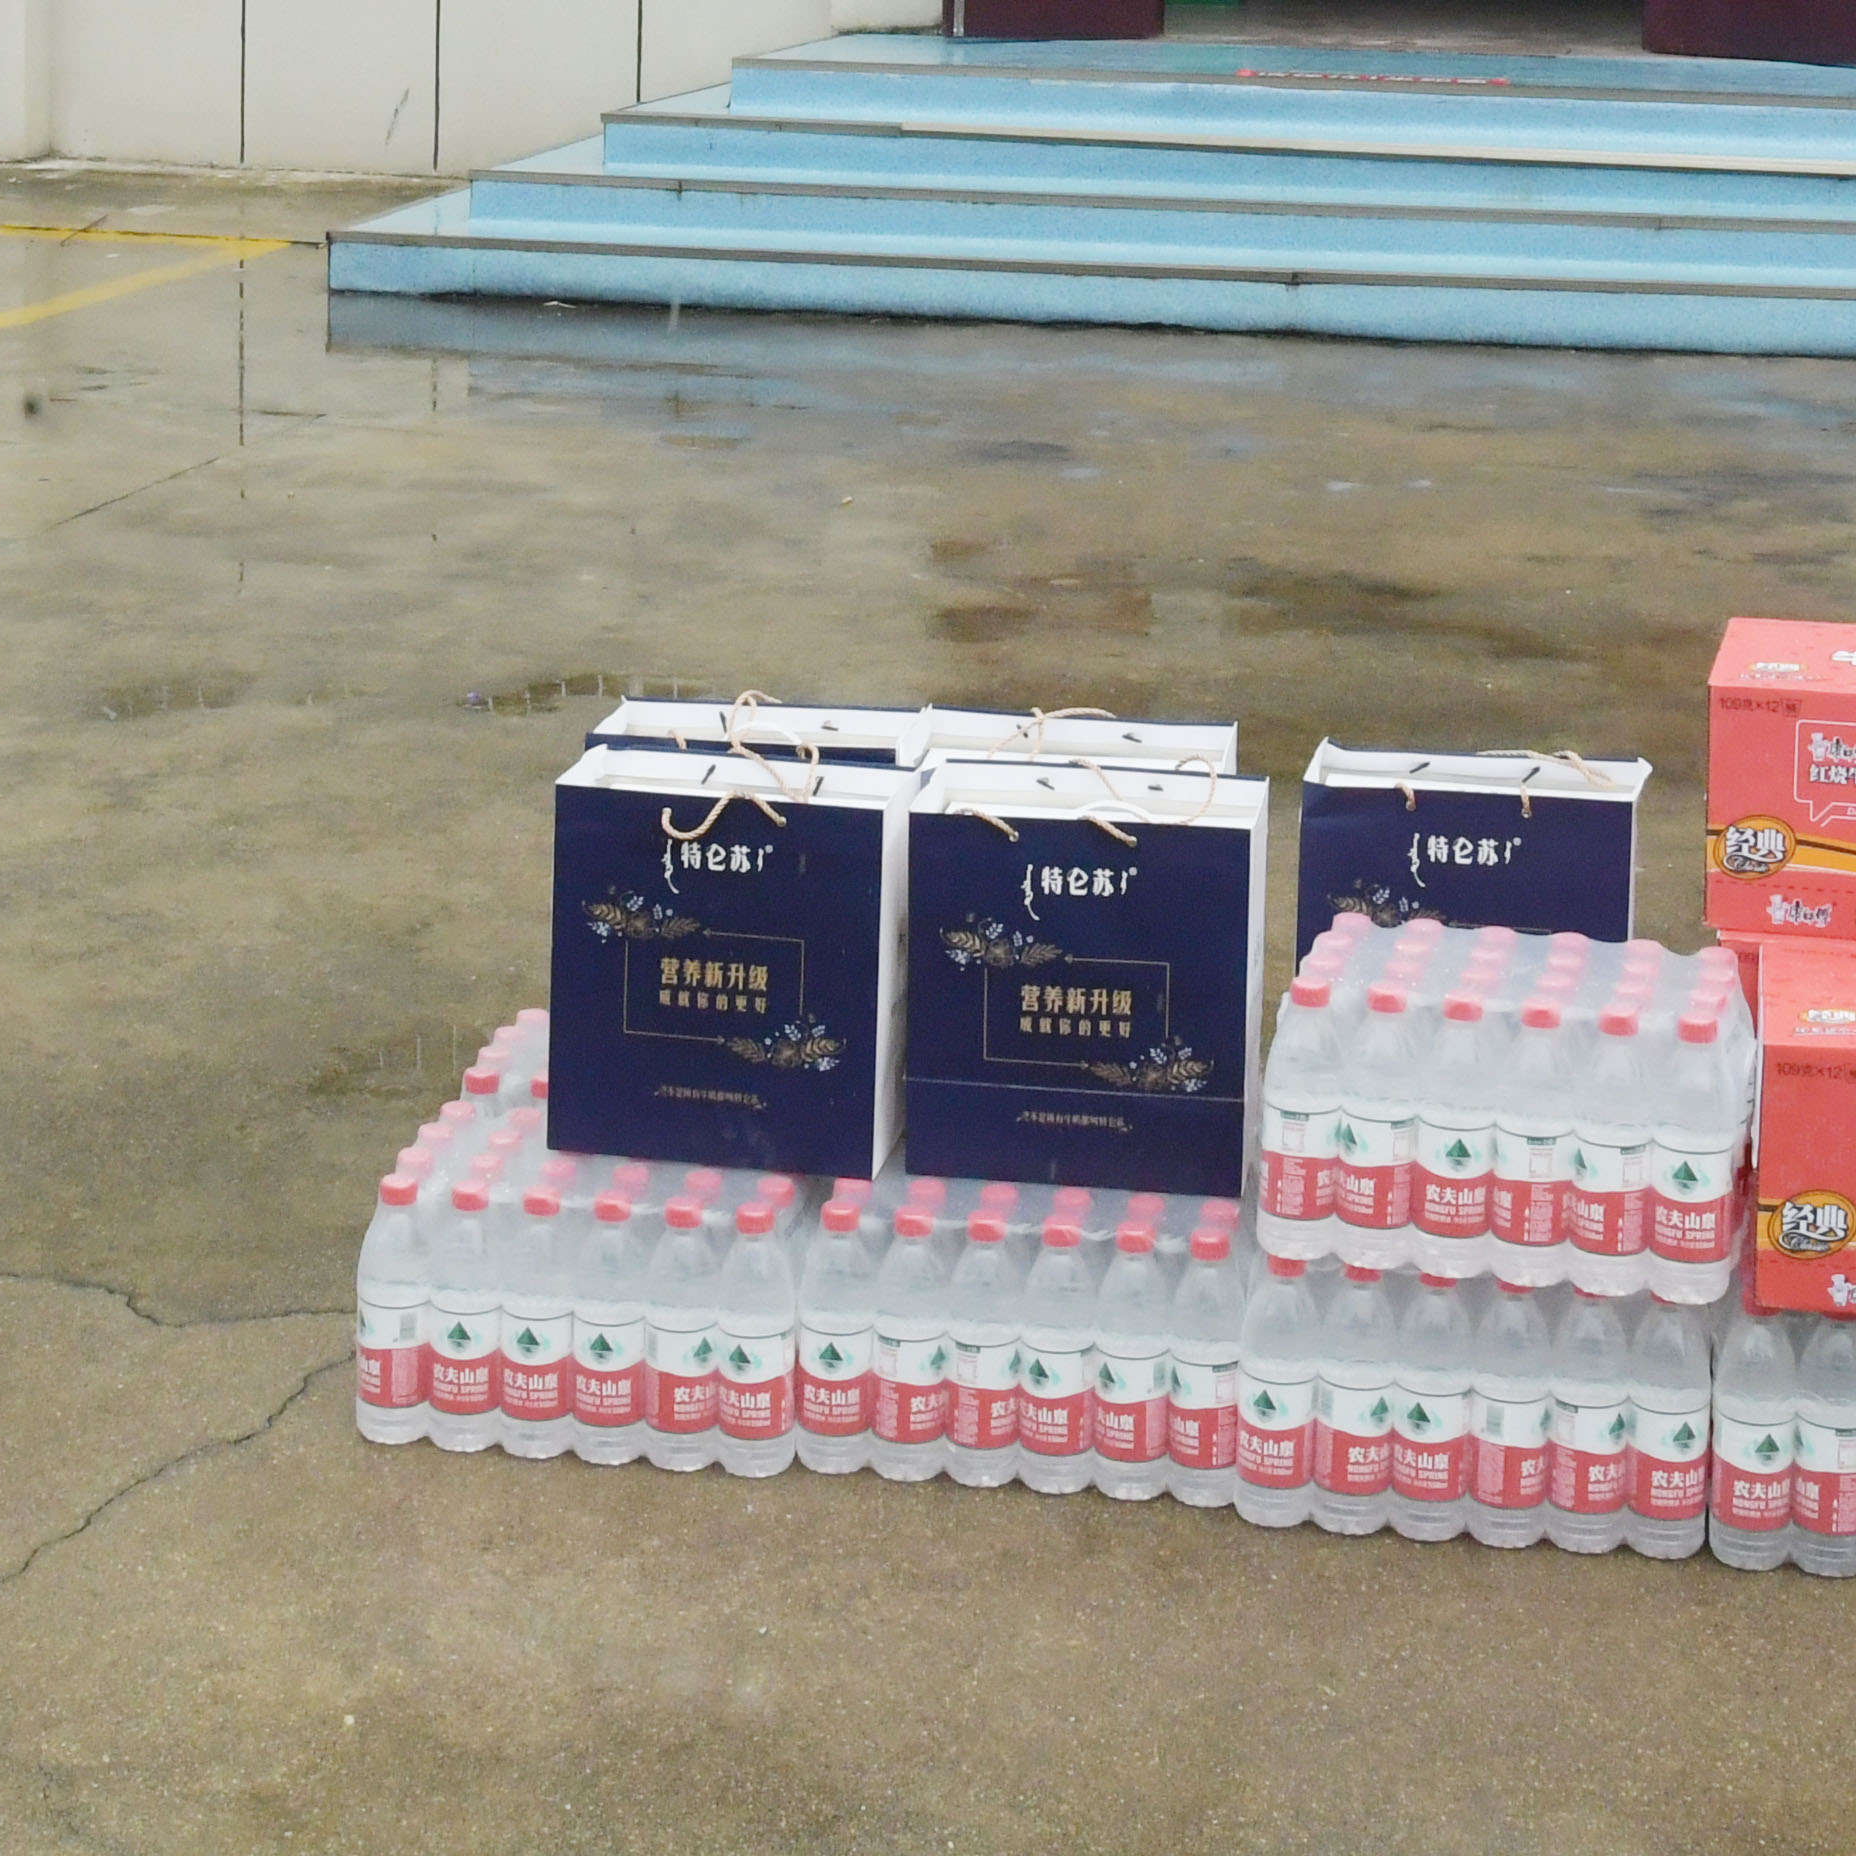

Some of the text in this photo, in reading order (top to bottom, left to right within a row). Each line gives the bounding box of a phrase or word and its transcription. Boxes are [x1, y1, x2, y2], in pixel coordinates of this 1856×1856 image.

[1427, 835, 1499, 866] 特仑苏
[1725, 825, 1785, 856] 经典
[680, 841, 751, 873] 特仑苏
[1041, 866, 1115, 896] 特仑苏
[660, 957, 768, 992] 营养新升级
[1021, 985, 1132, 1016] 营养新升级
[1655, 1205, 1716, 1230] 农夫山泉
[1781, 1201, 1848, 1234] 经典
[433, 1363, 489, 1384] 农夫山泉
[504, 1368, 559, 1390] 农夫山泉
[576, 1374, 632, 1396] 农夫山泉
[804, 1384, 860, 1405] 农夫山泉
